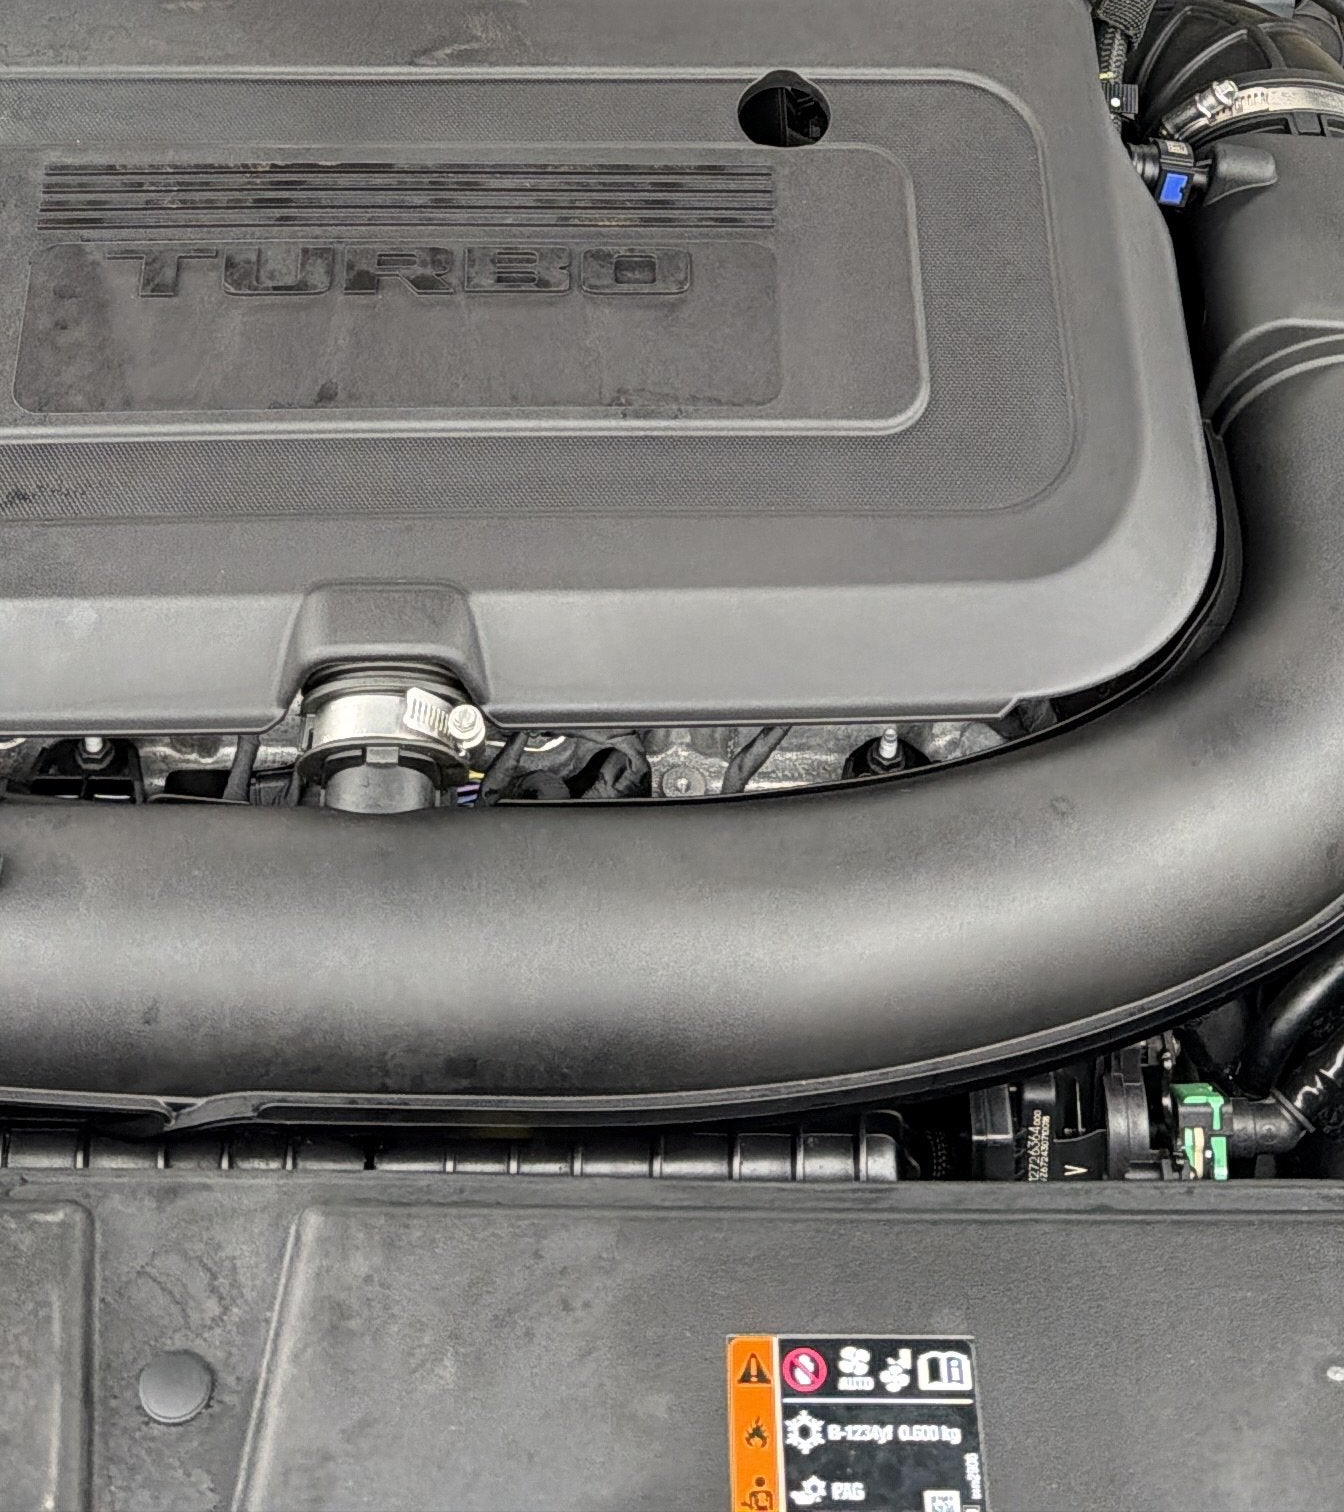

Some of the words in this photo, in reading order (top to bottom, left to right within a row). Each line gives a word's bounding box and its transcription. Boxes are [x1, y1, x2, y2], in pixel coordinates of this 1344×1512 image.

[106, 246, 692, 298] TURBO
[941, 1424, 962, 1445] kg
[831, 1482, 865, 1501] PAG
